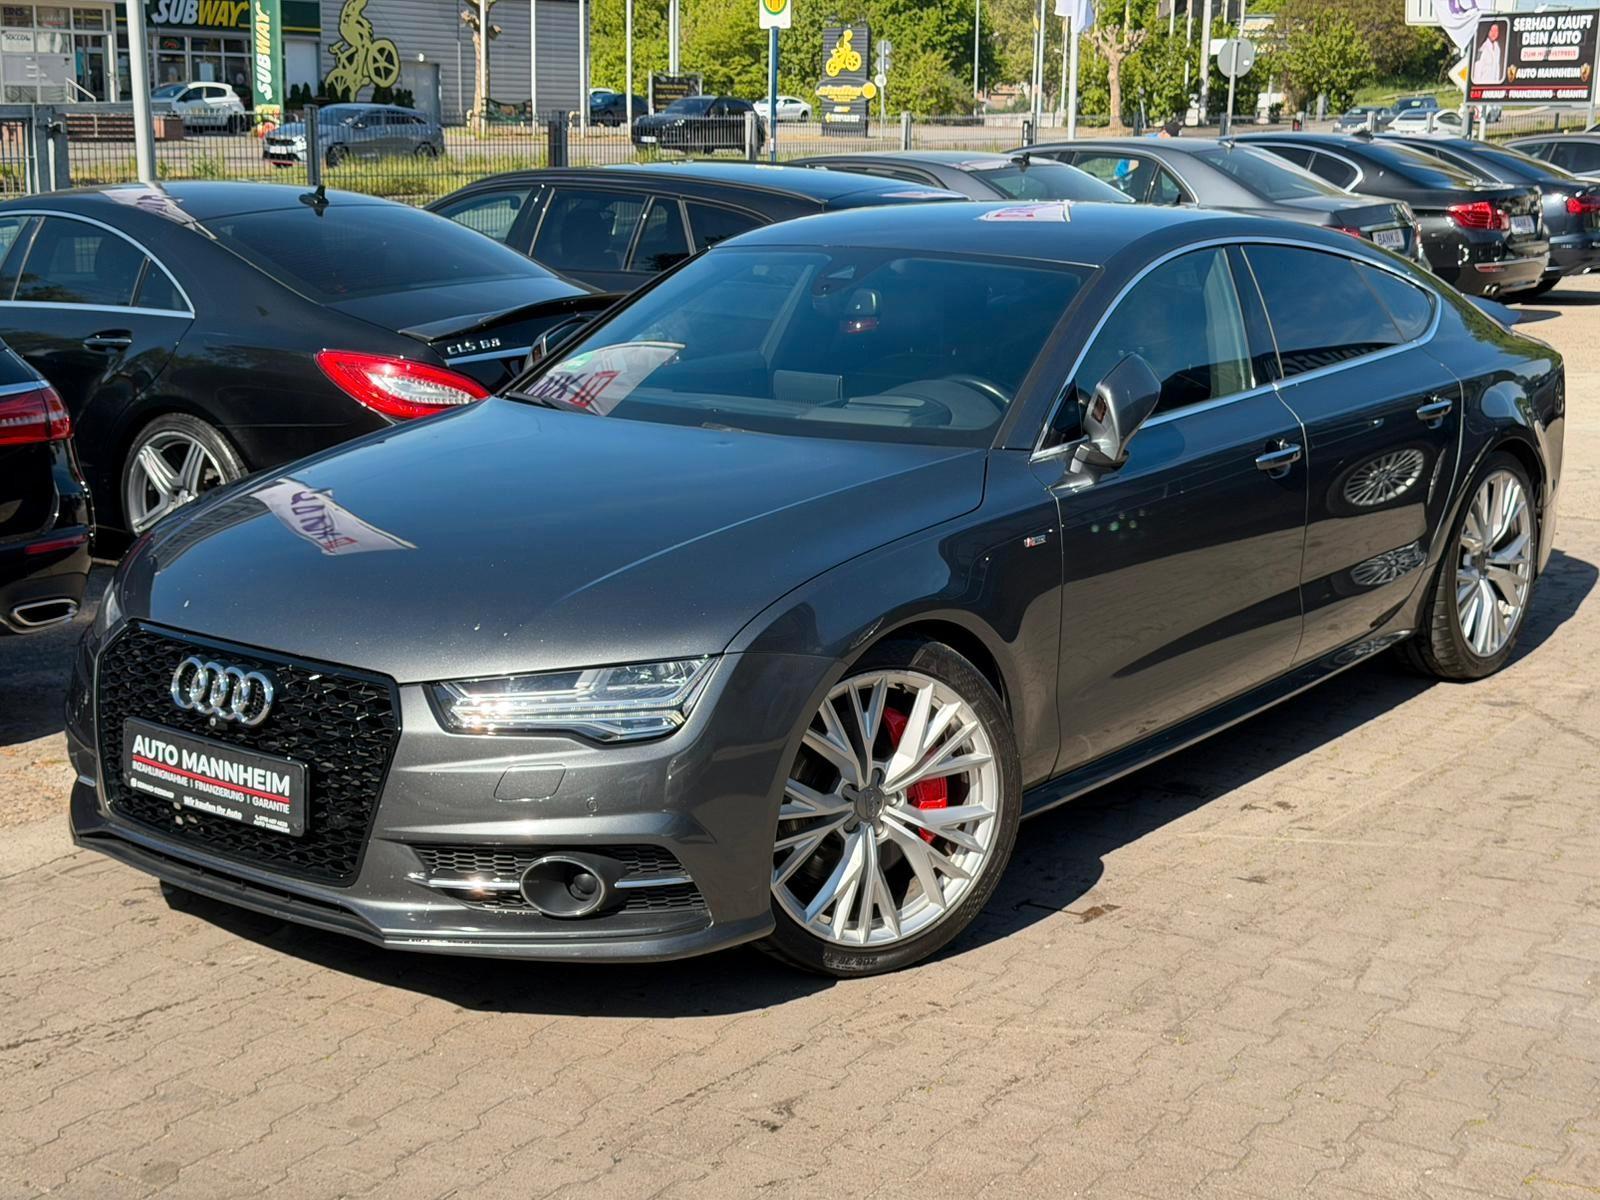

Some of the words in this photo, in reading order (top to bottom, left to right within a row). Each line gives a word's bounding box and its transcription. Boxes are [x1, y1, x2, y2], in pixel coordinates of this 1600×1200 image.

[151, 0, 249, 27] SUBWAY
[1513, 16, 1556, 32] SERHAD
[1557, 14, 1594, 30] KAUFT
[1522, 31, 1548, 46] DEIN
[1550, 30, 1582, 45] AUTO
[255, 1, 273, 100] SUBWAY
[1516, 68, 1536, 79] AUTO
[1537, 67, 1581, 78] MANNHEIM
[447, 341, 476, 355] CLS
[132, 735, 178, 766] AUTO
[182, 749, 291, 796] MANNHEIM
[194, 780, 245, 802] FINANZIERUNG
[252, 796, 290, 814] GARANTIE
